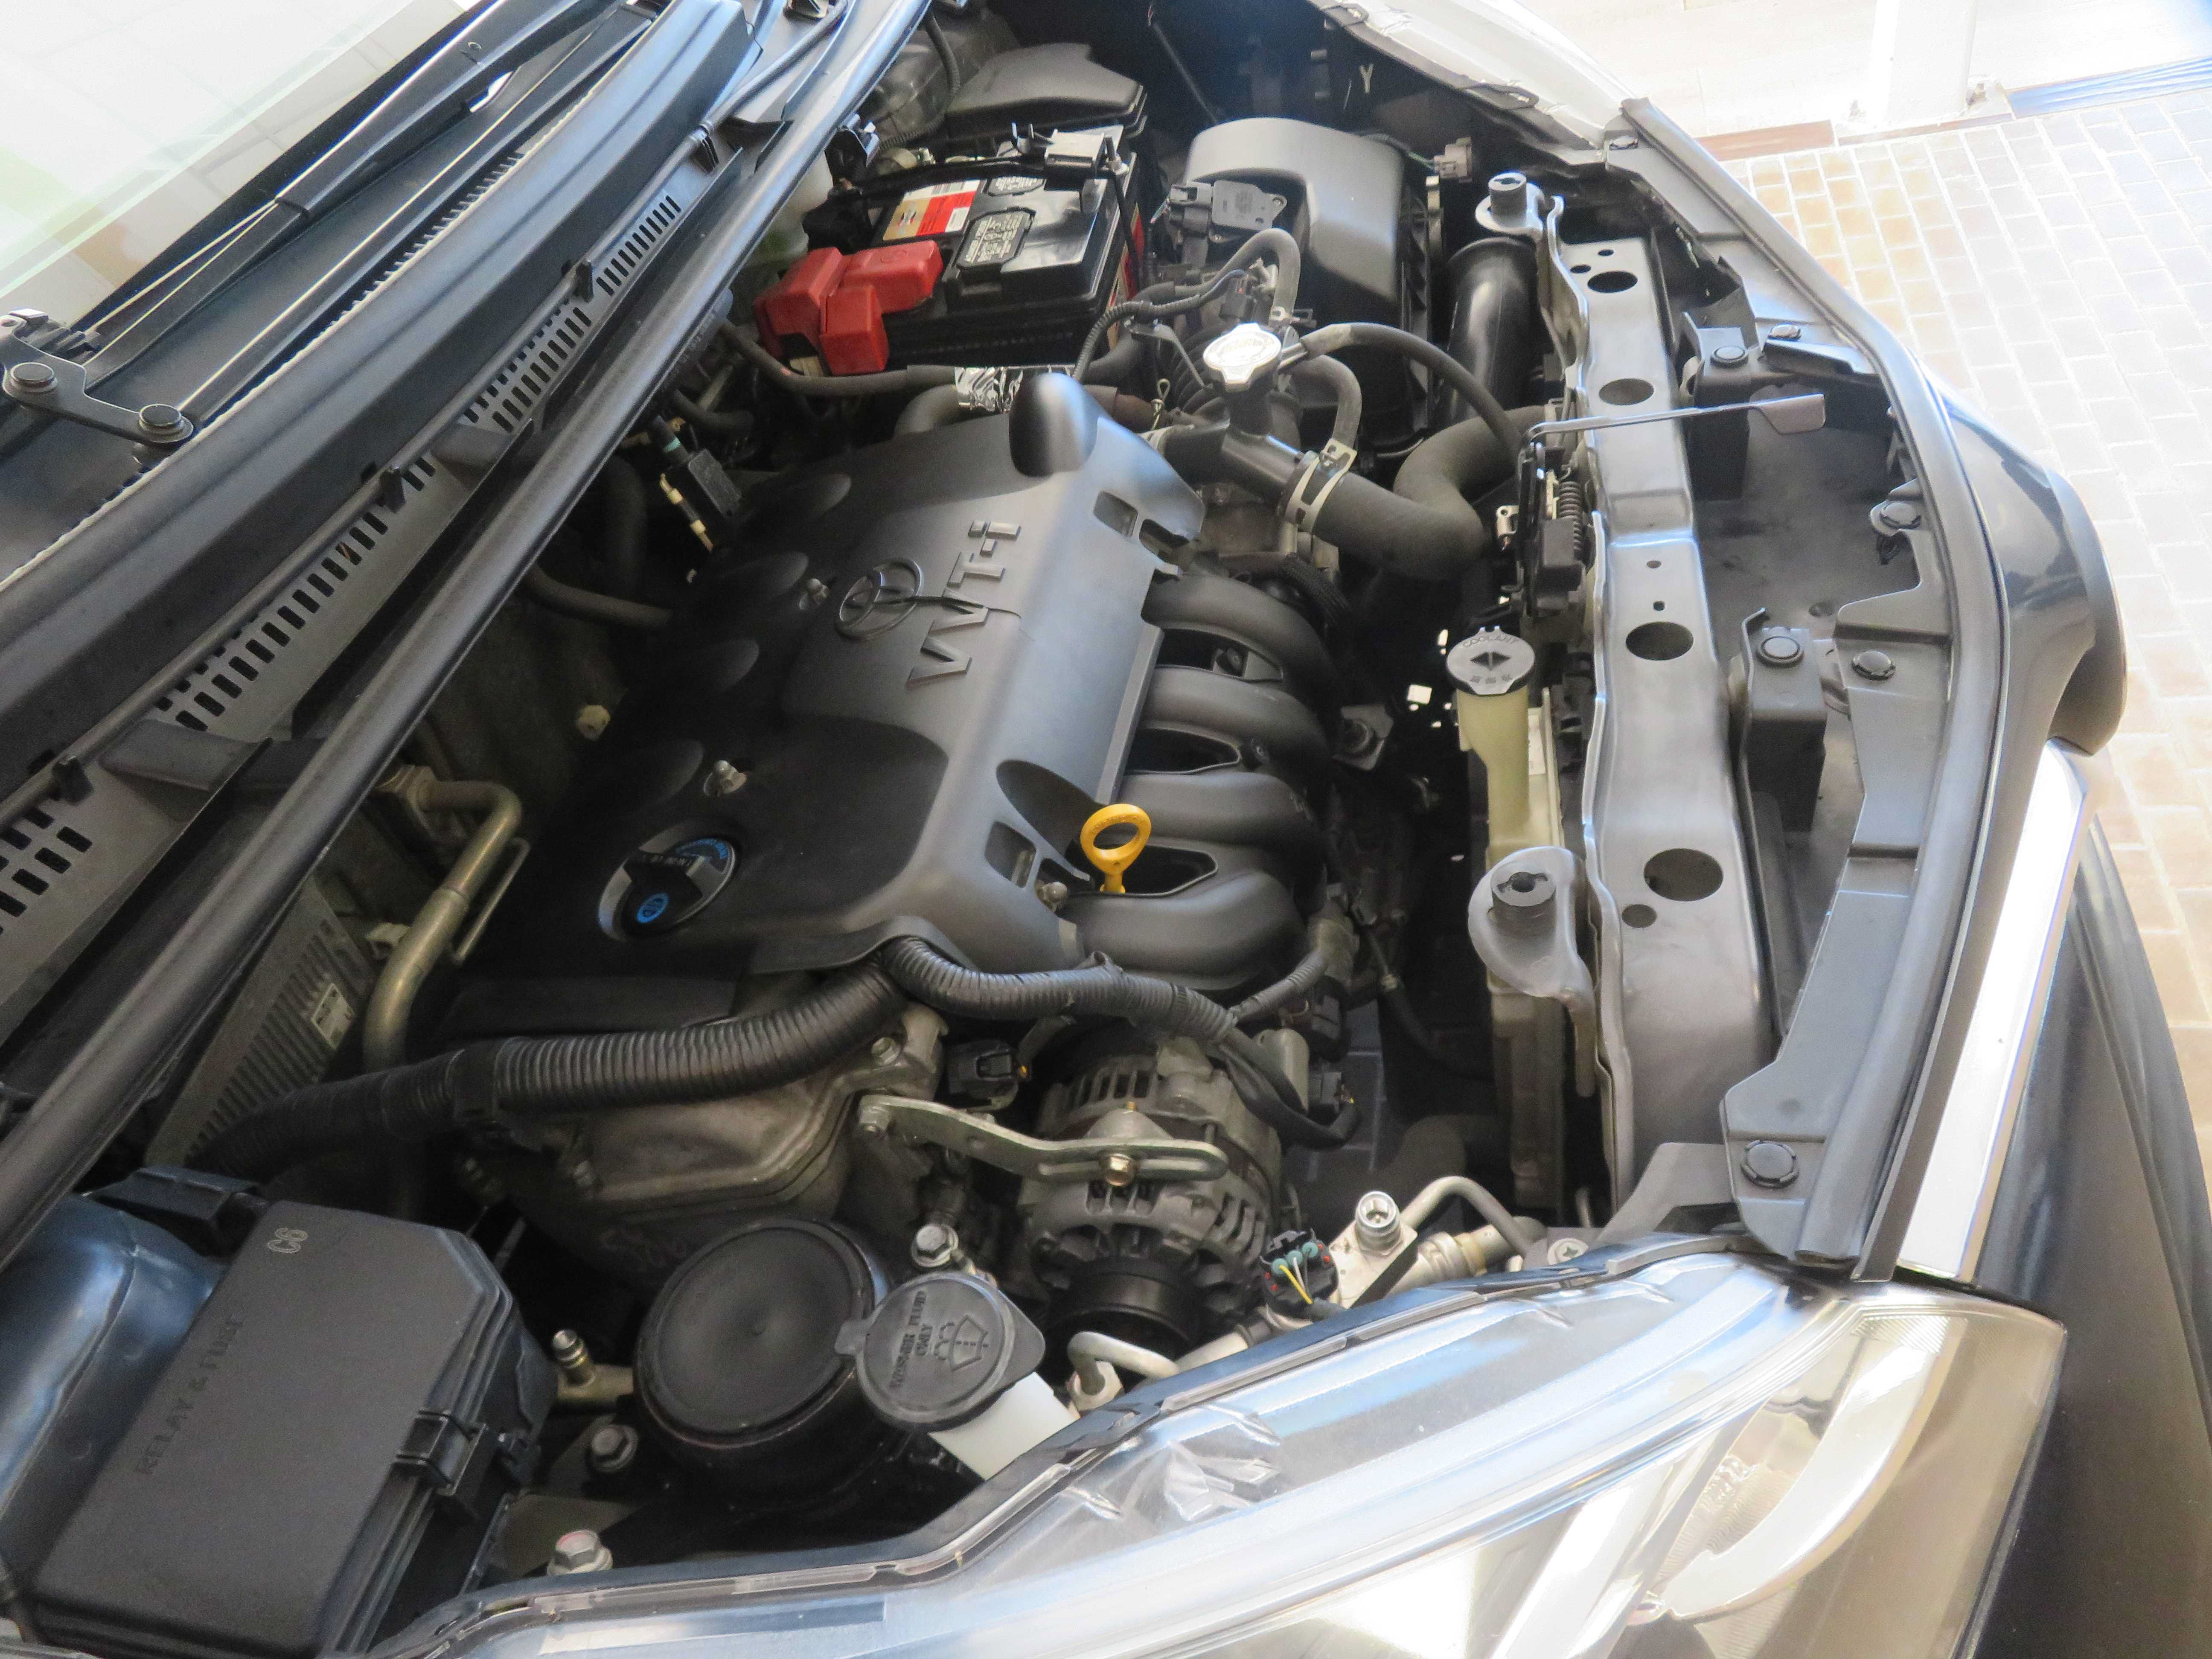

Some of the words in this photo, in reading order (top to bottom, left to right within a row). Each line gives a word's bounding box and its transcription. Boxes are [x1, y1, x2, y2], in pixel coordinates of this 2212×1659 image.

[1463, 634, 1517, 647] COOLANT
[916, 1324, 933, 1356] ONLY
[137, 1397, 193, 1475] RELAY
